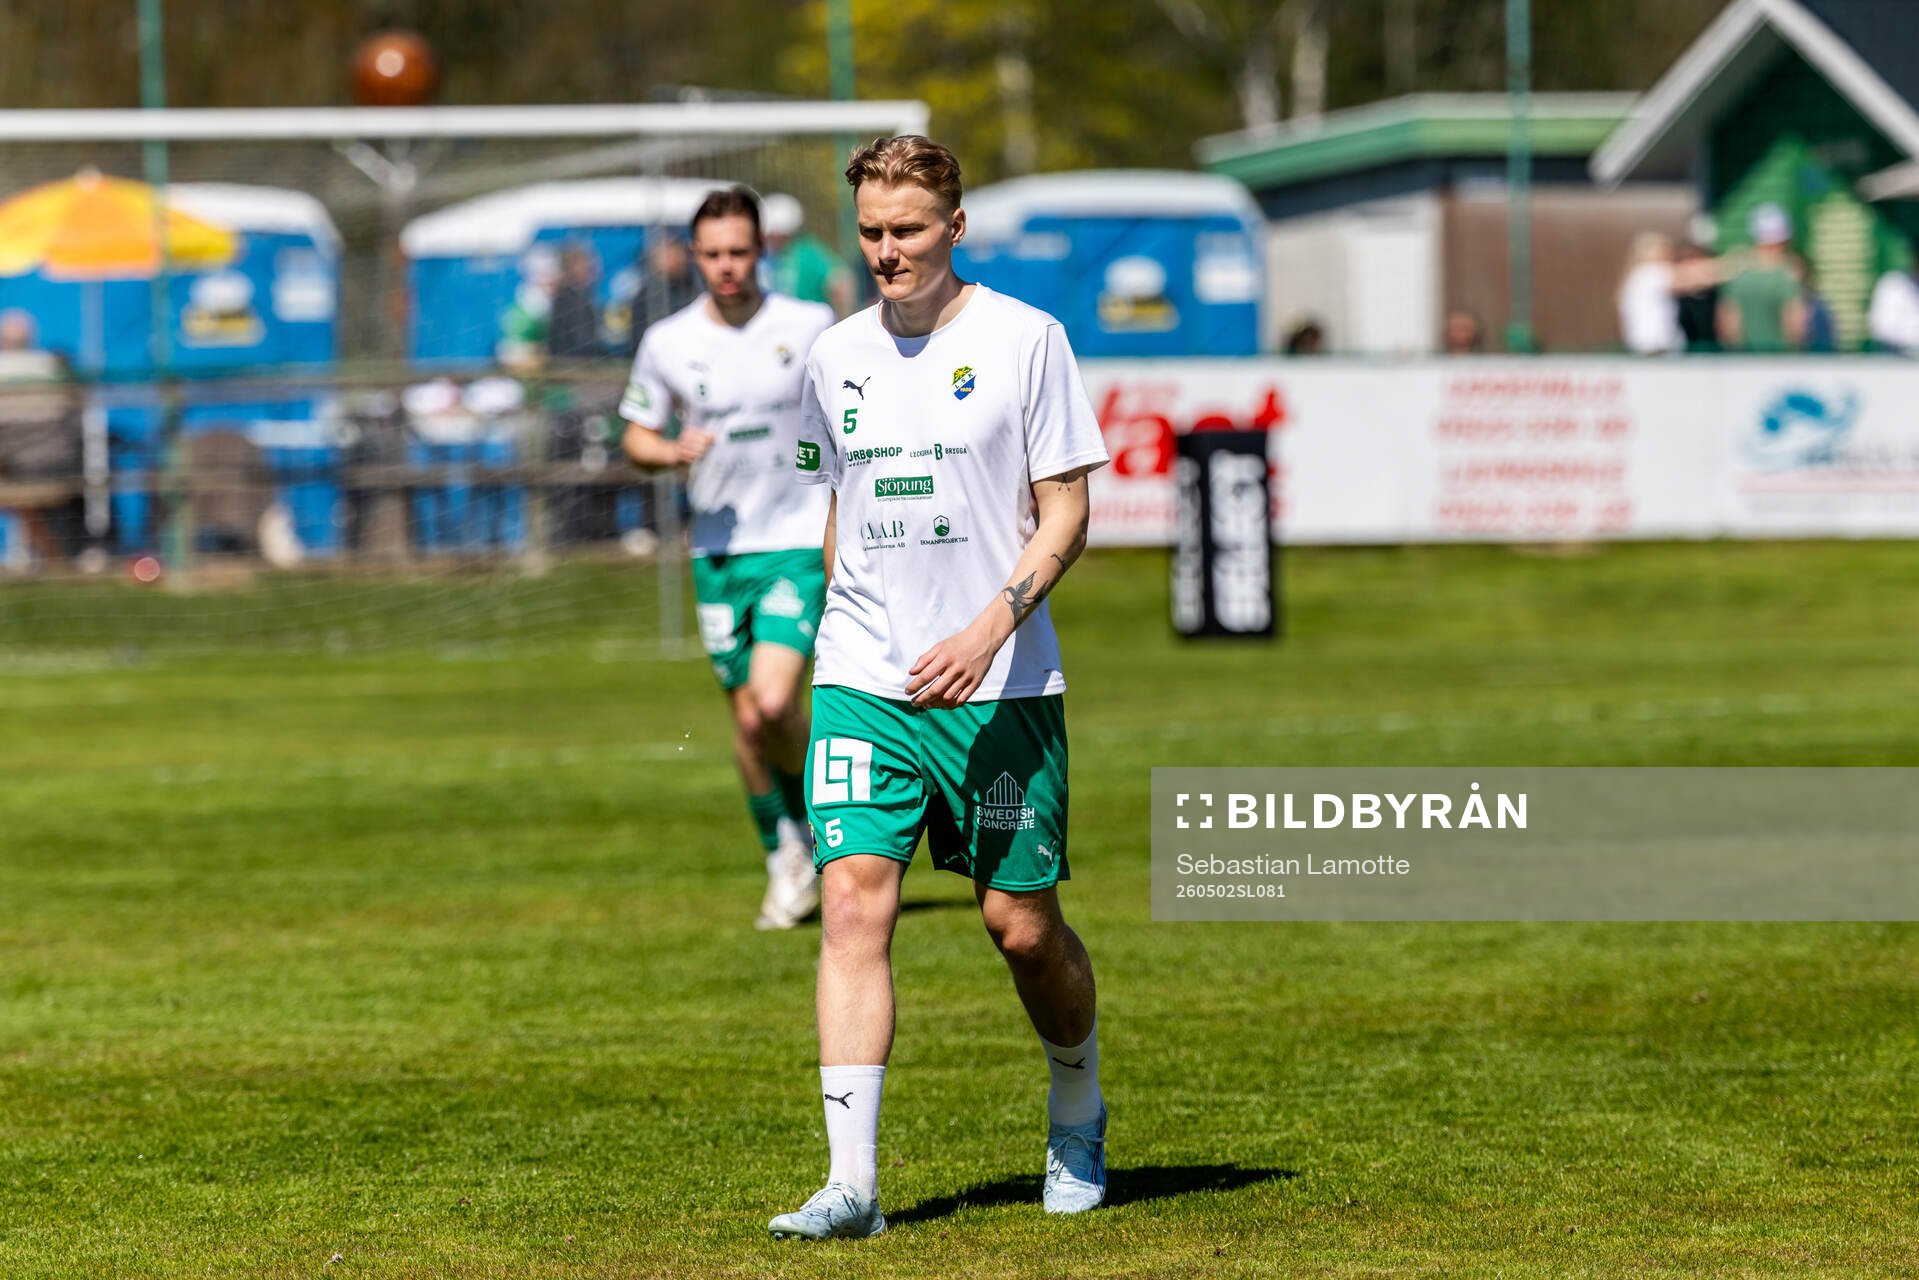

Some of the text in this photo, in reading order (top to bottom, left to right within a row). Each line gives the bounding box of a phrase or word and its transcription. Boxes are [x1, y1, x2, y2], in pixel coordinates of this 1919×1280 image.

[843, 408, 858, 434] 5
[796, 446, 816, 459] ET
[933, 443, 943, 460] B
[877, 478, 932, 495] Sjöpung
[976, 805, 1035, 821] SWEDISH
[976, 817, 1035, 831] CONCRETE
[825, 818, 844, 848] 5
